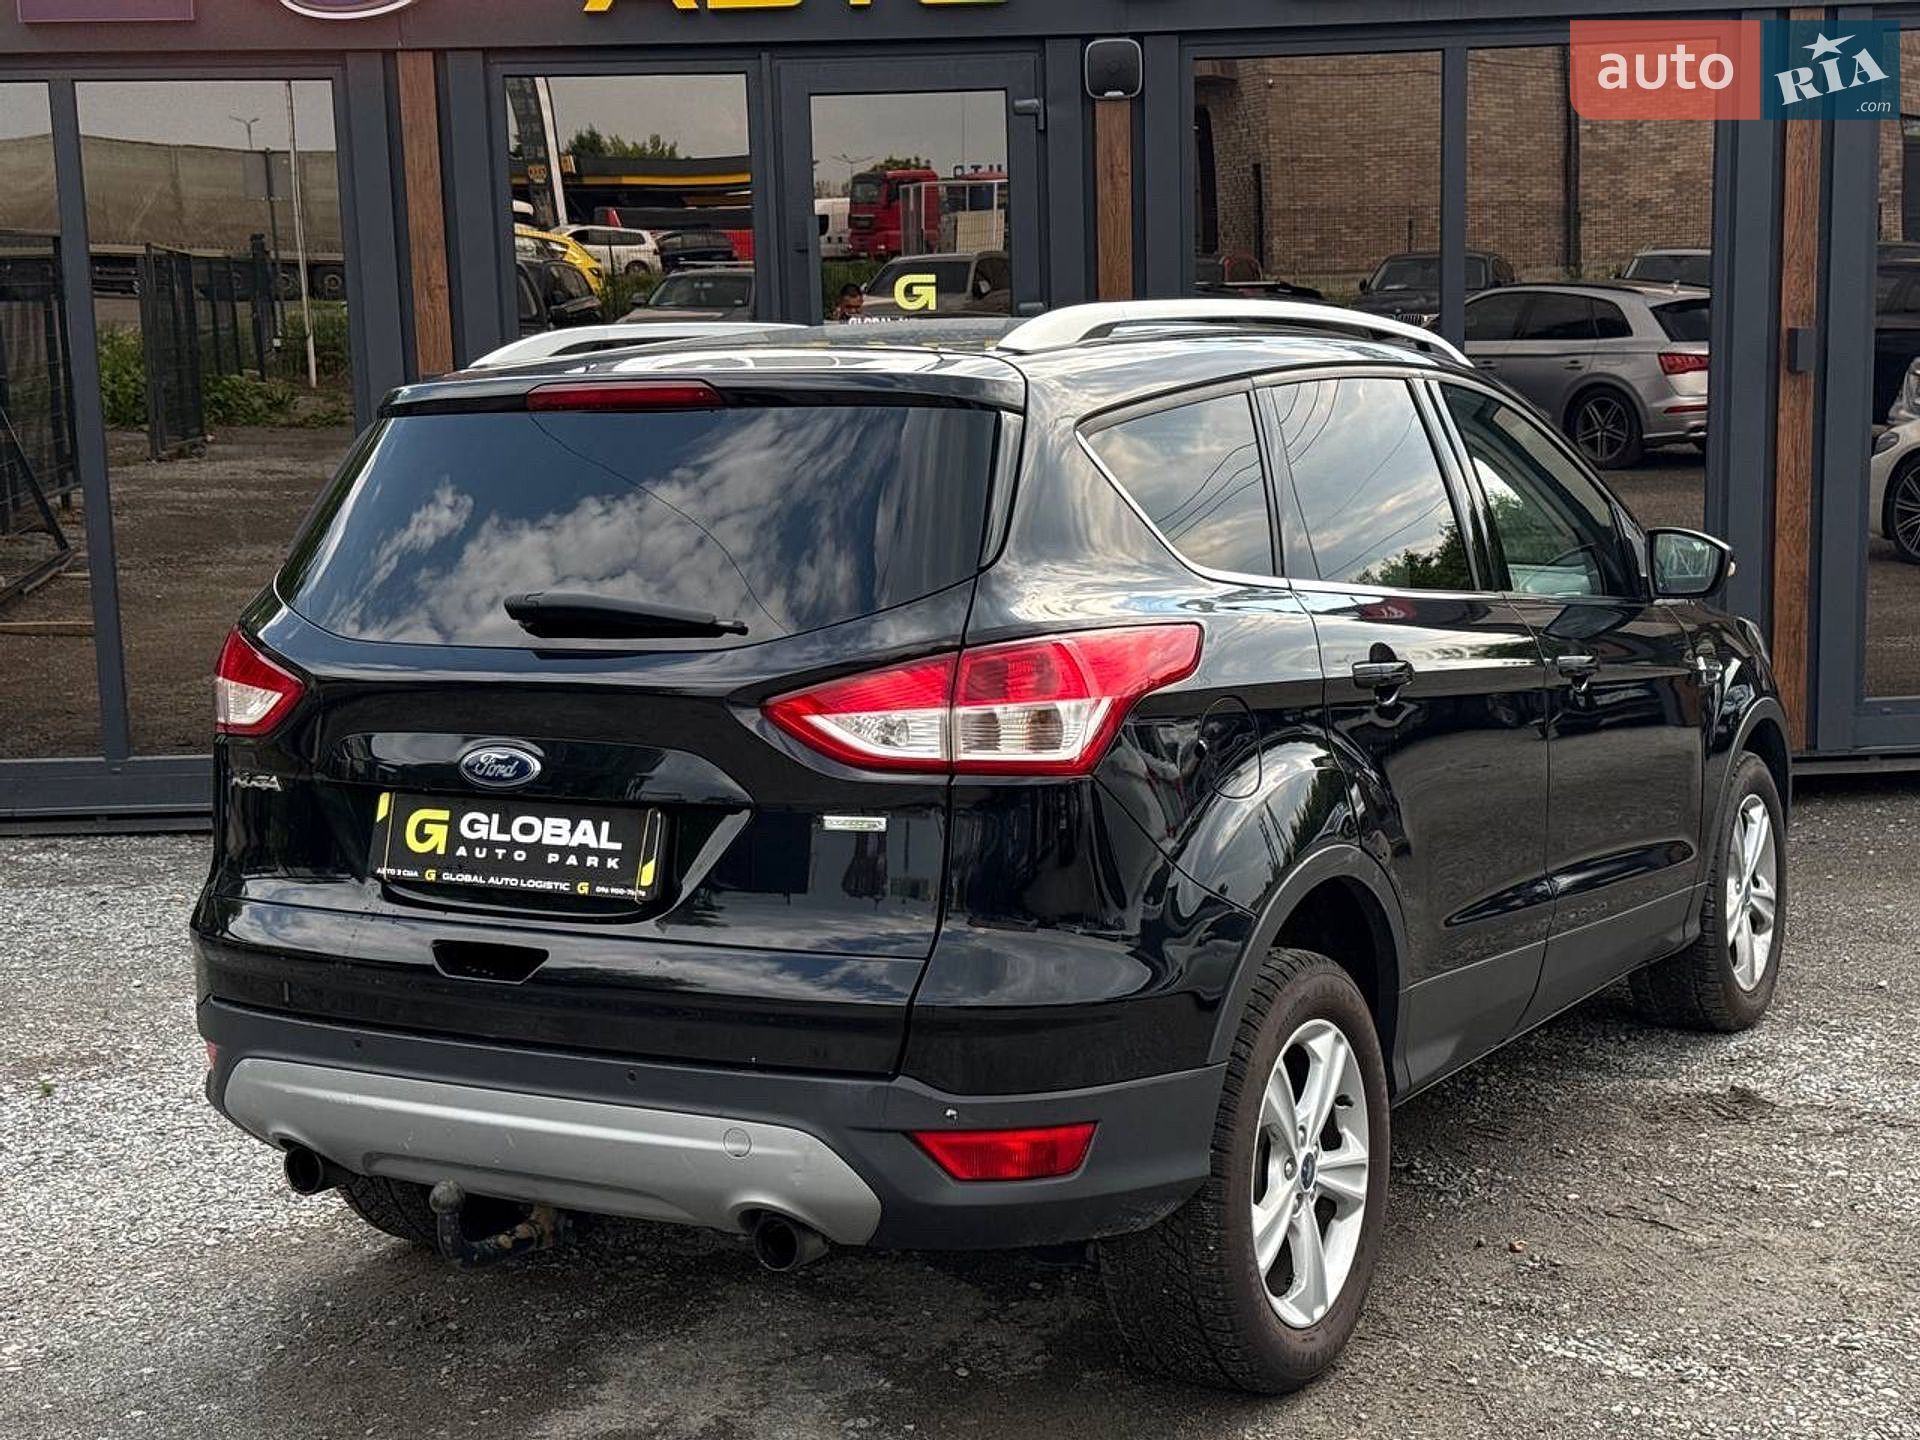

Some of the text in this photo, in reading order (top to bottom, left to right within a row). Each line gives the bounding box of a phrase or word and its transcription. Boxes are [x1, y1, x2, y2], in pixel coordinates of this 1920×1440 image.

[474, 753, 520, 778] Ford
[460, 811, 622, 850] GLOBAL
[456, 846, 620, 869] AUTO PARK
[442, 872, 571, 891] GLOBAL AUTO LOGISTIC
